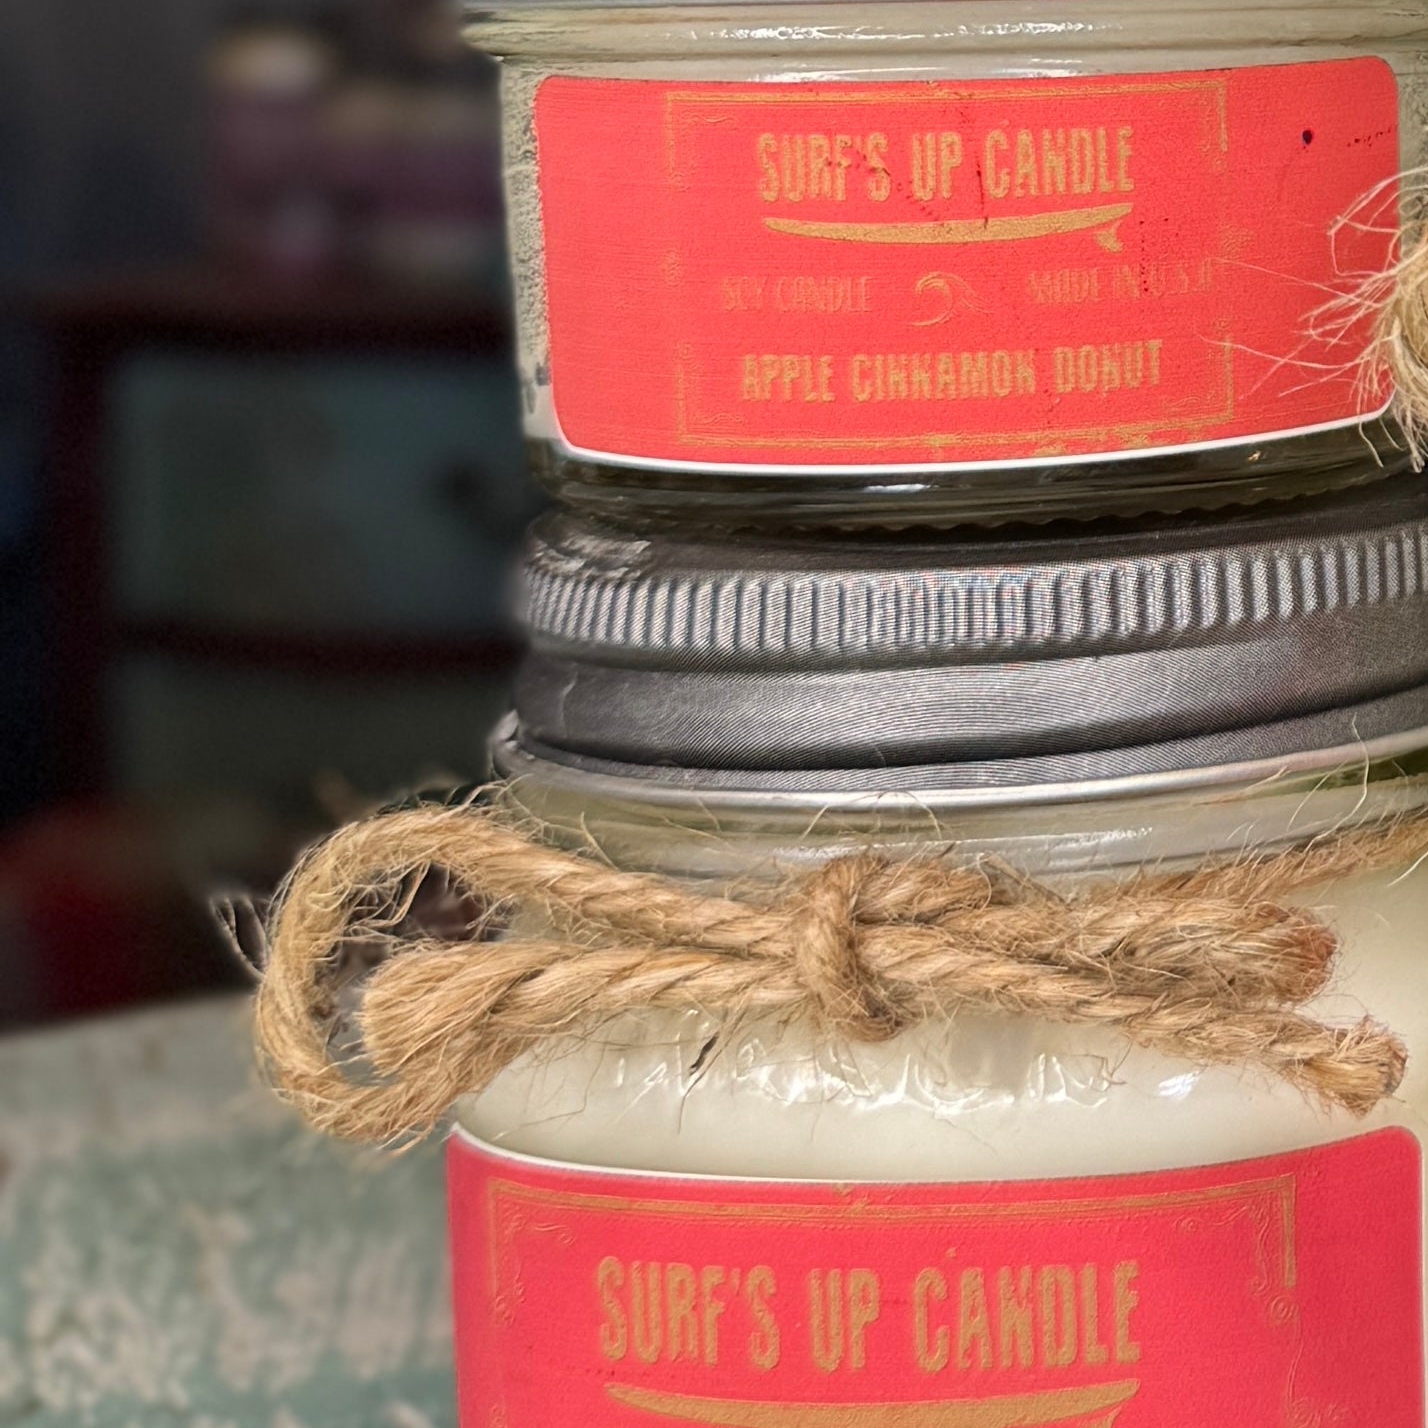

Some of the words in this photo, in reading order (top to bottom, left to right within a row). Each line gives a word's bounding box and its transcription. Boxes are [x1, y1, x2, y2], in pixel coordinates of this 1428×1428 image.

[757, 130, 890, 202] SURF'S
[910, 130, 963, 199] UP
[984, 126, 1134, 196] CANDLE
[776, 276, 872, 312] CANDLE
[742, 354, 835, 403] APPLE
[851, 349, 1038, 402] CINNAMON
[1053, 339, 1163, 394] DONUT
[596, 1256, 779, 1371] SURF'S
[808, 1267, 880, 1373] UP
[913, 1258, 1141, 1371] CANDLE
